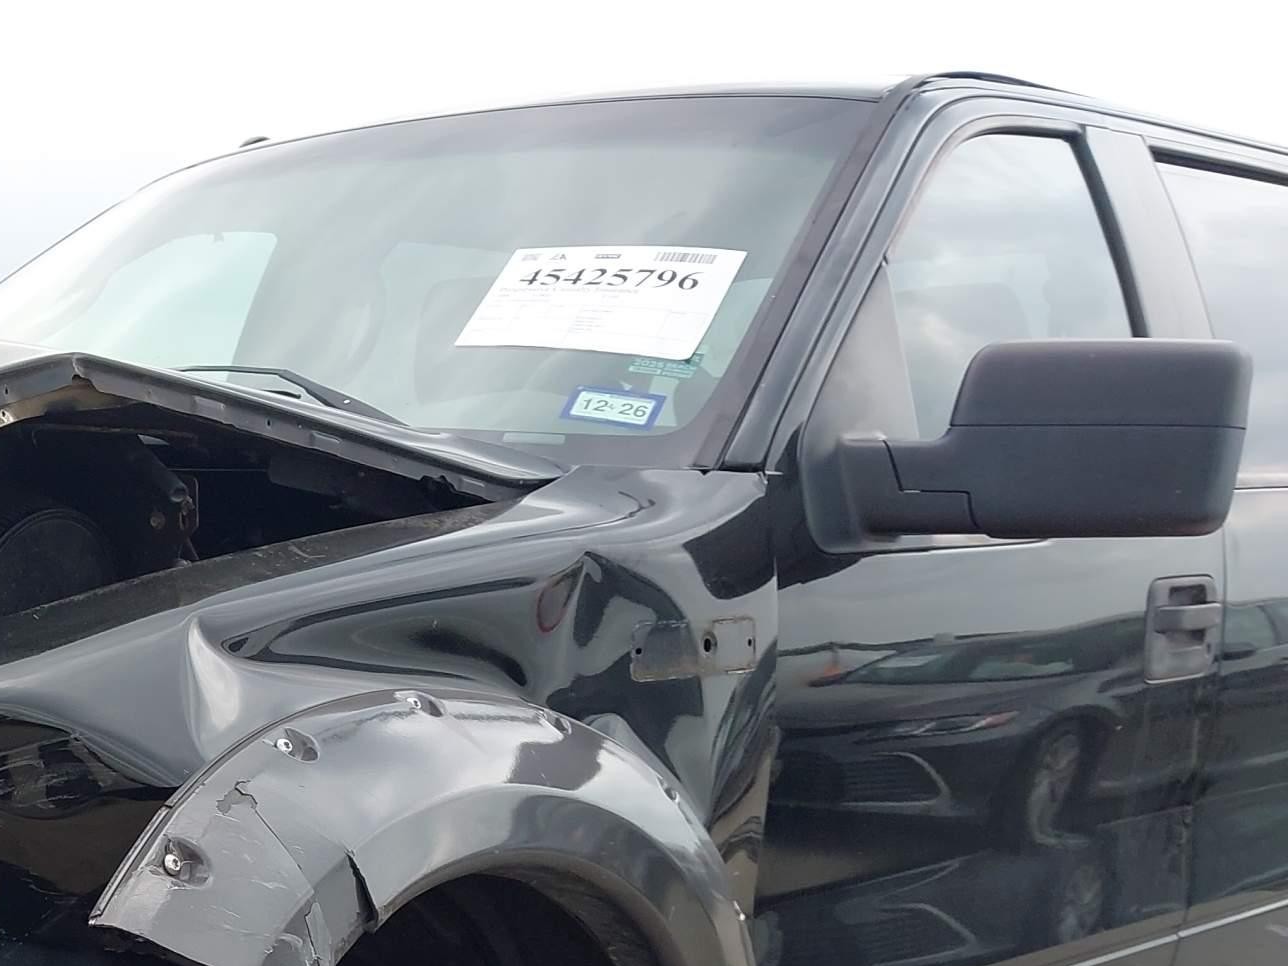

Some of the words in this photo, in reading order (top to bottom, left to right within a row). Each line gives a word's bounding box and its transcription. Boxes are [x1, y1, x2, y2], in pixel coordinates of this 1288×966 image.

[519, 267, 704, 291] 45425796
[582, 397, 610, 413] 12
[616, 402, 649, 418] 26
